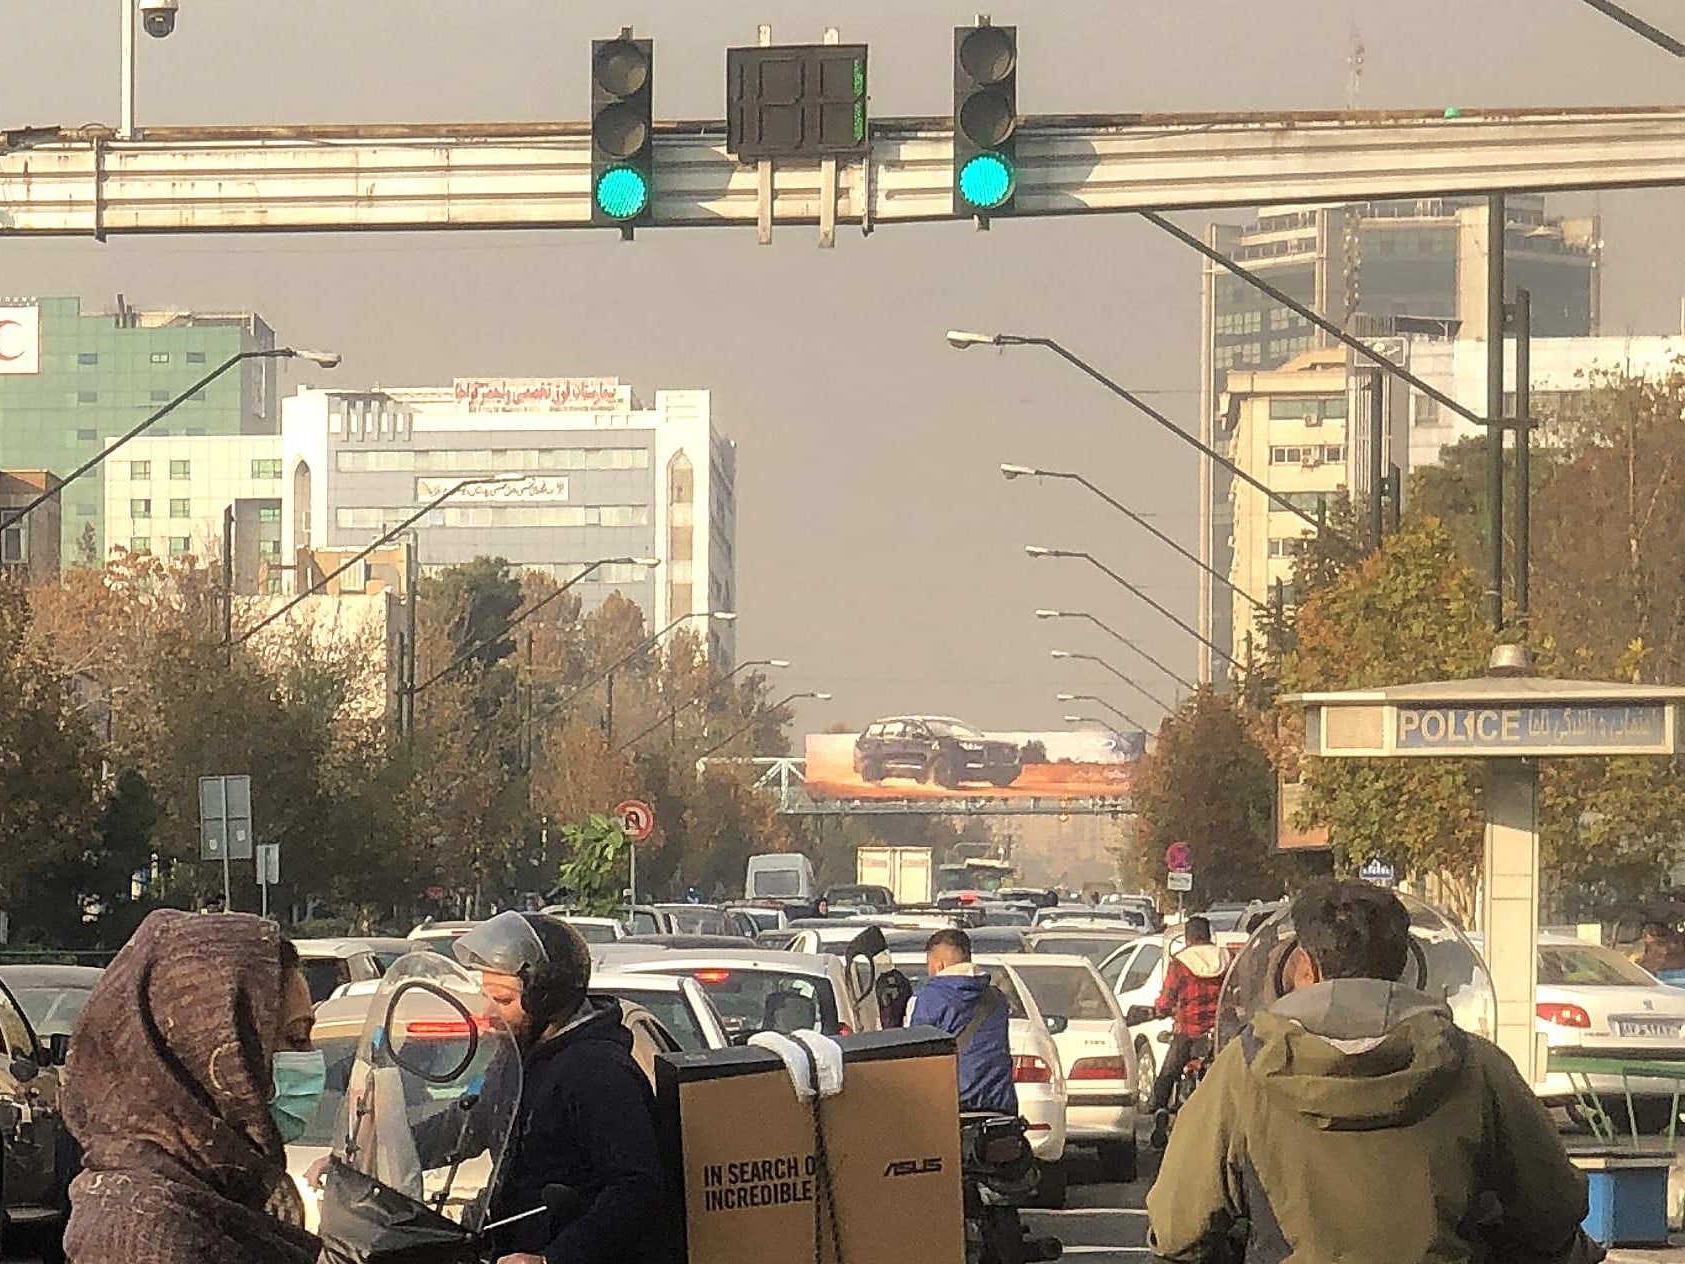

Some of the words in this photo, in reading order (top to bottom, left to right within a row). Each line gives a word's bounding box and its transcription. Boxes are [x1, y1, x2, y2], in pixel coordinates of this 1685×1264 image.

[1399, 709, 1521, 742] POLICE
[704, 1165, 723, 1187] IN
[728, 1156, 799, 1185] SEARCH
[805, 1155, 816, 1177] O
[883, 1157, 942, 1177] ASUS
[705, 1179, 814, 1212] INCREDIBLE
